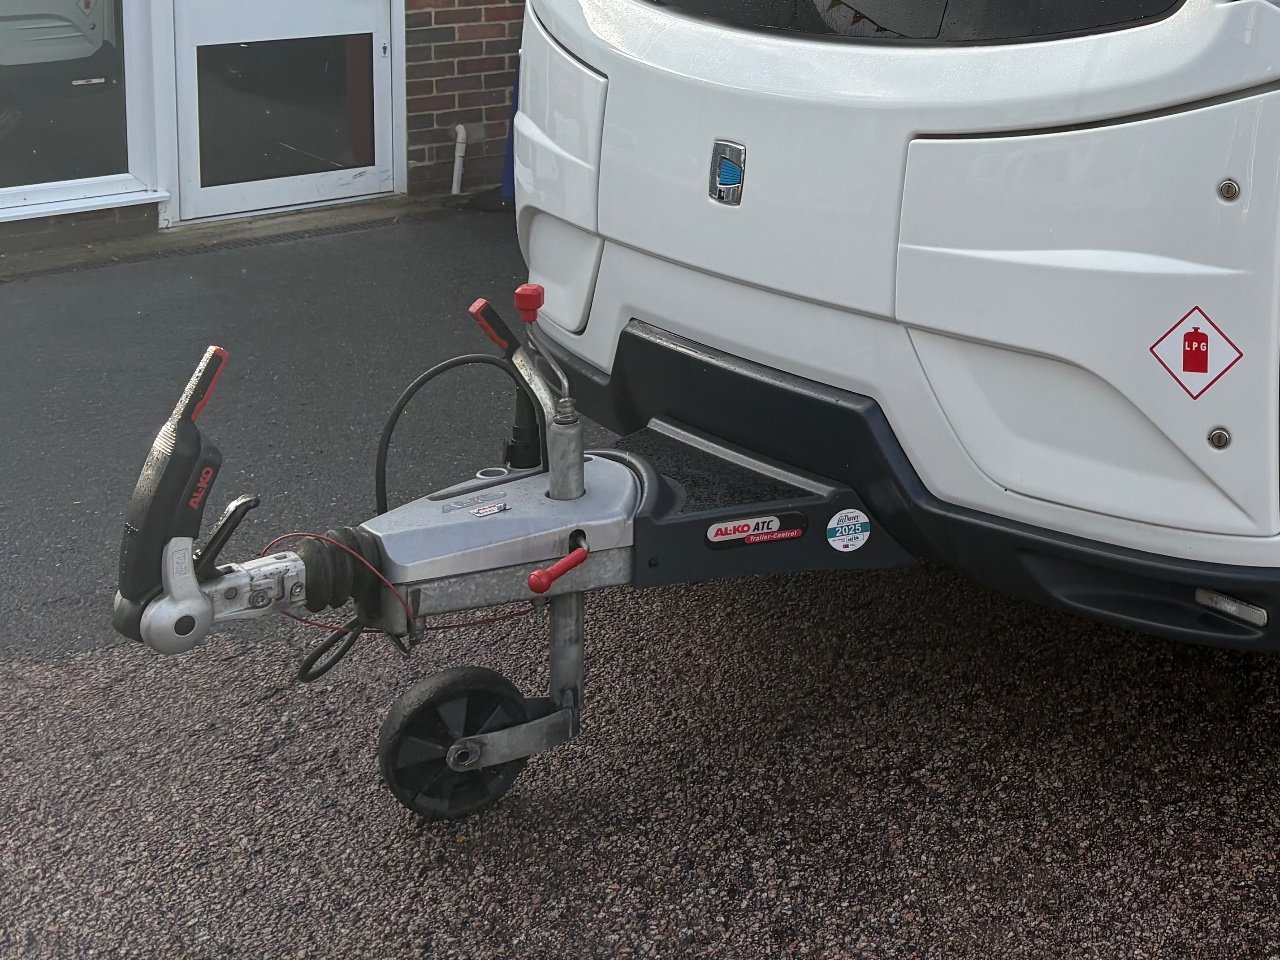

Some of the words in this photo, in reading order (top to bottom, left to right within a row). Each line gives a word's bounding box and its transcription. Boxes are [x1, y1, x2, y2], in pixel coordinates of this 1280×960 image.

[1185, 341, 1207, 351] LPG
[713, 523, 751, 538] AL-KO
[752, 520, 774, 532] ATC
[835, 524, 862, 537] 2025
[750, 530, 798, 542] Trailer-Control
